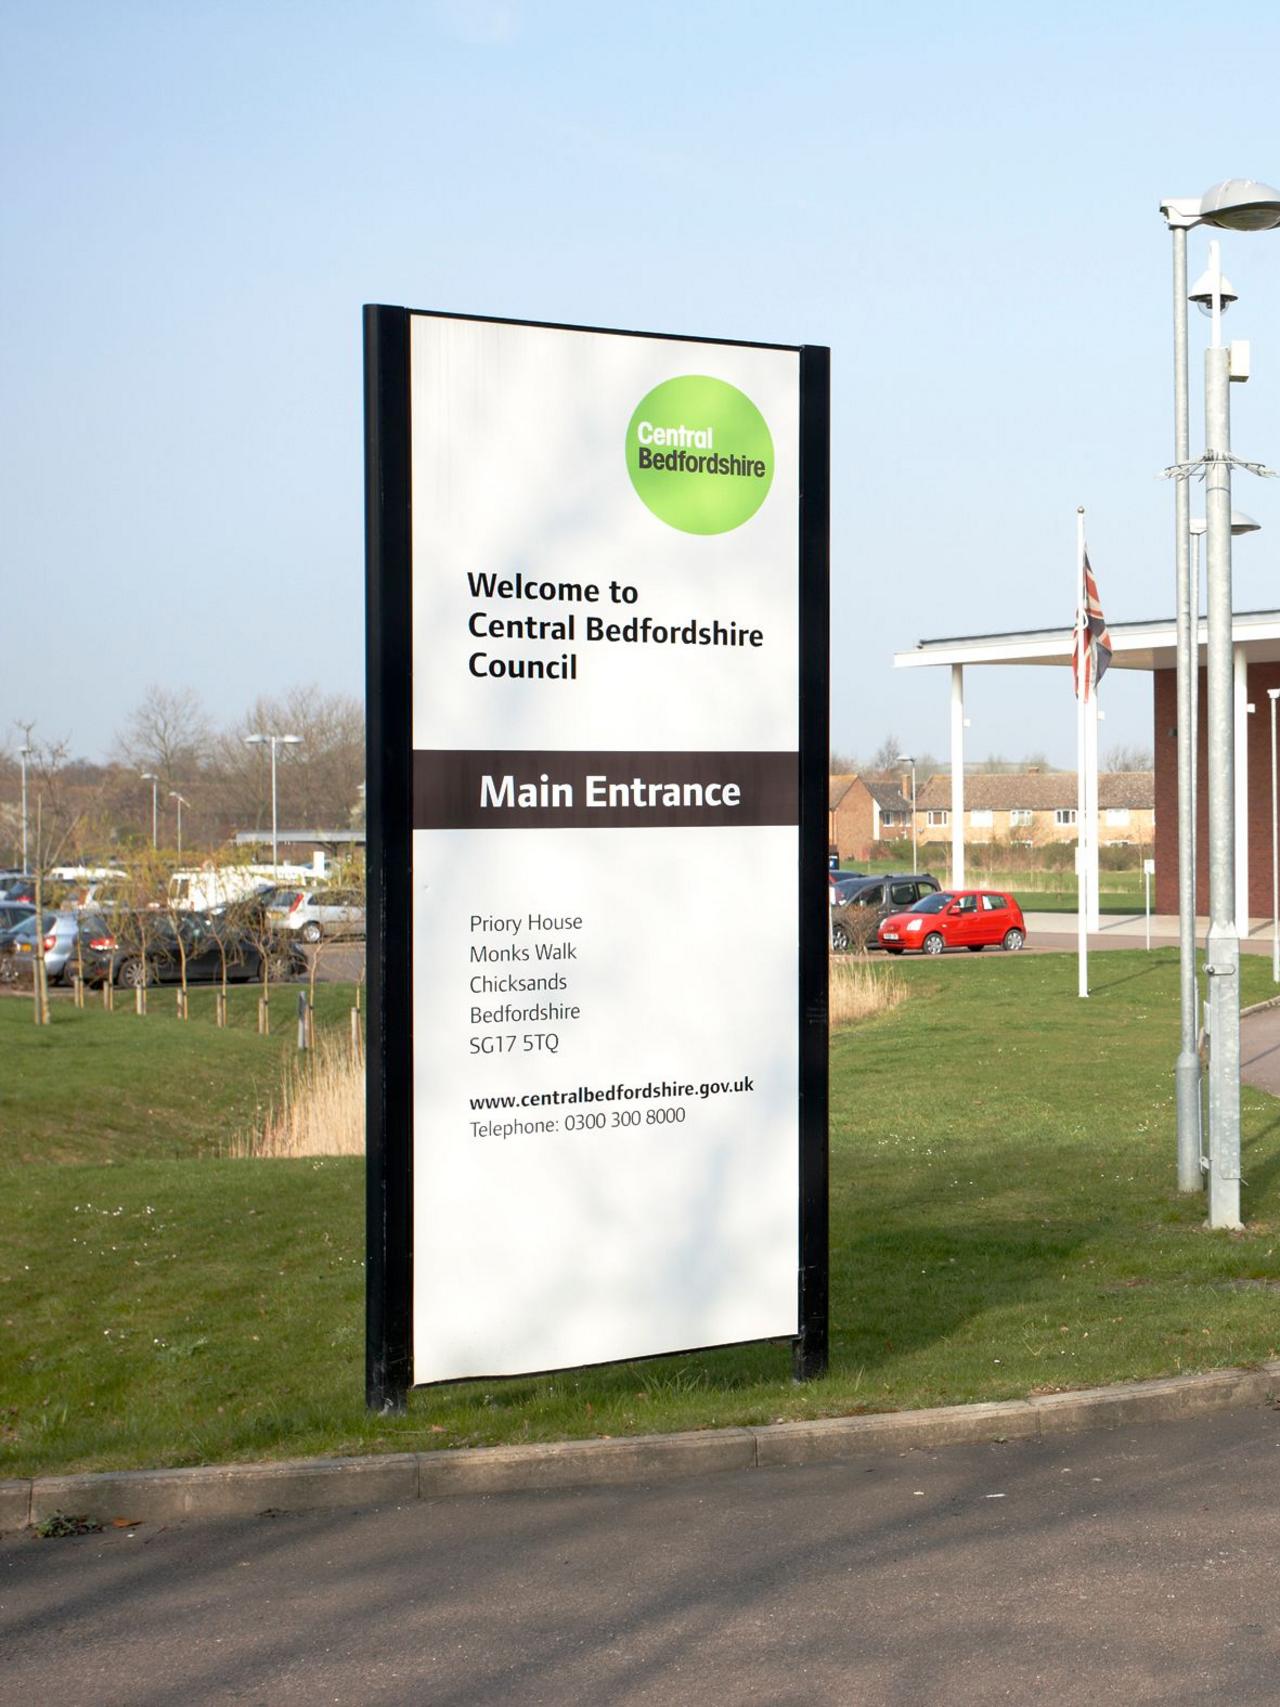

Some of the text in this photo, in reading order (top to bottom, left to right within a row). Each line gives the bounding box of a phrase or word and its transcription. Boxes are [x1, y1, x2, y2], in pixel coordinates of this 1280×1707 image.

[638, 422, 712, 448] Central
[639, 447, 765, 477] Bedfordshire
[467, 572, 639, 604] Welcome to
[469, 612, 763, 647] Central Bedfordshire
[469, 652, 576, 679] Council
[481, 774, 740, 807] Main Entrance
[470, 913, 583, 935] Priory House
[470, 942, 577, 962] Monks Walk
[470, 973, 567, 993] Chicksands
[470, 1003, 581, 1024] Bedfordshire
[469, 1033, 559, 1054] SG17 5TQ
[470, 1076, 753, 1110] www.centralbedfordshire.gov.uk
[469, 1107, 686, 1139] Telephone: 0300 300 8000
